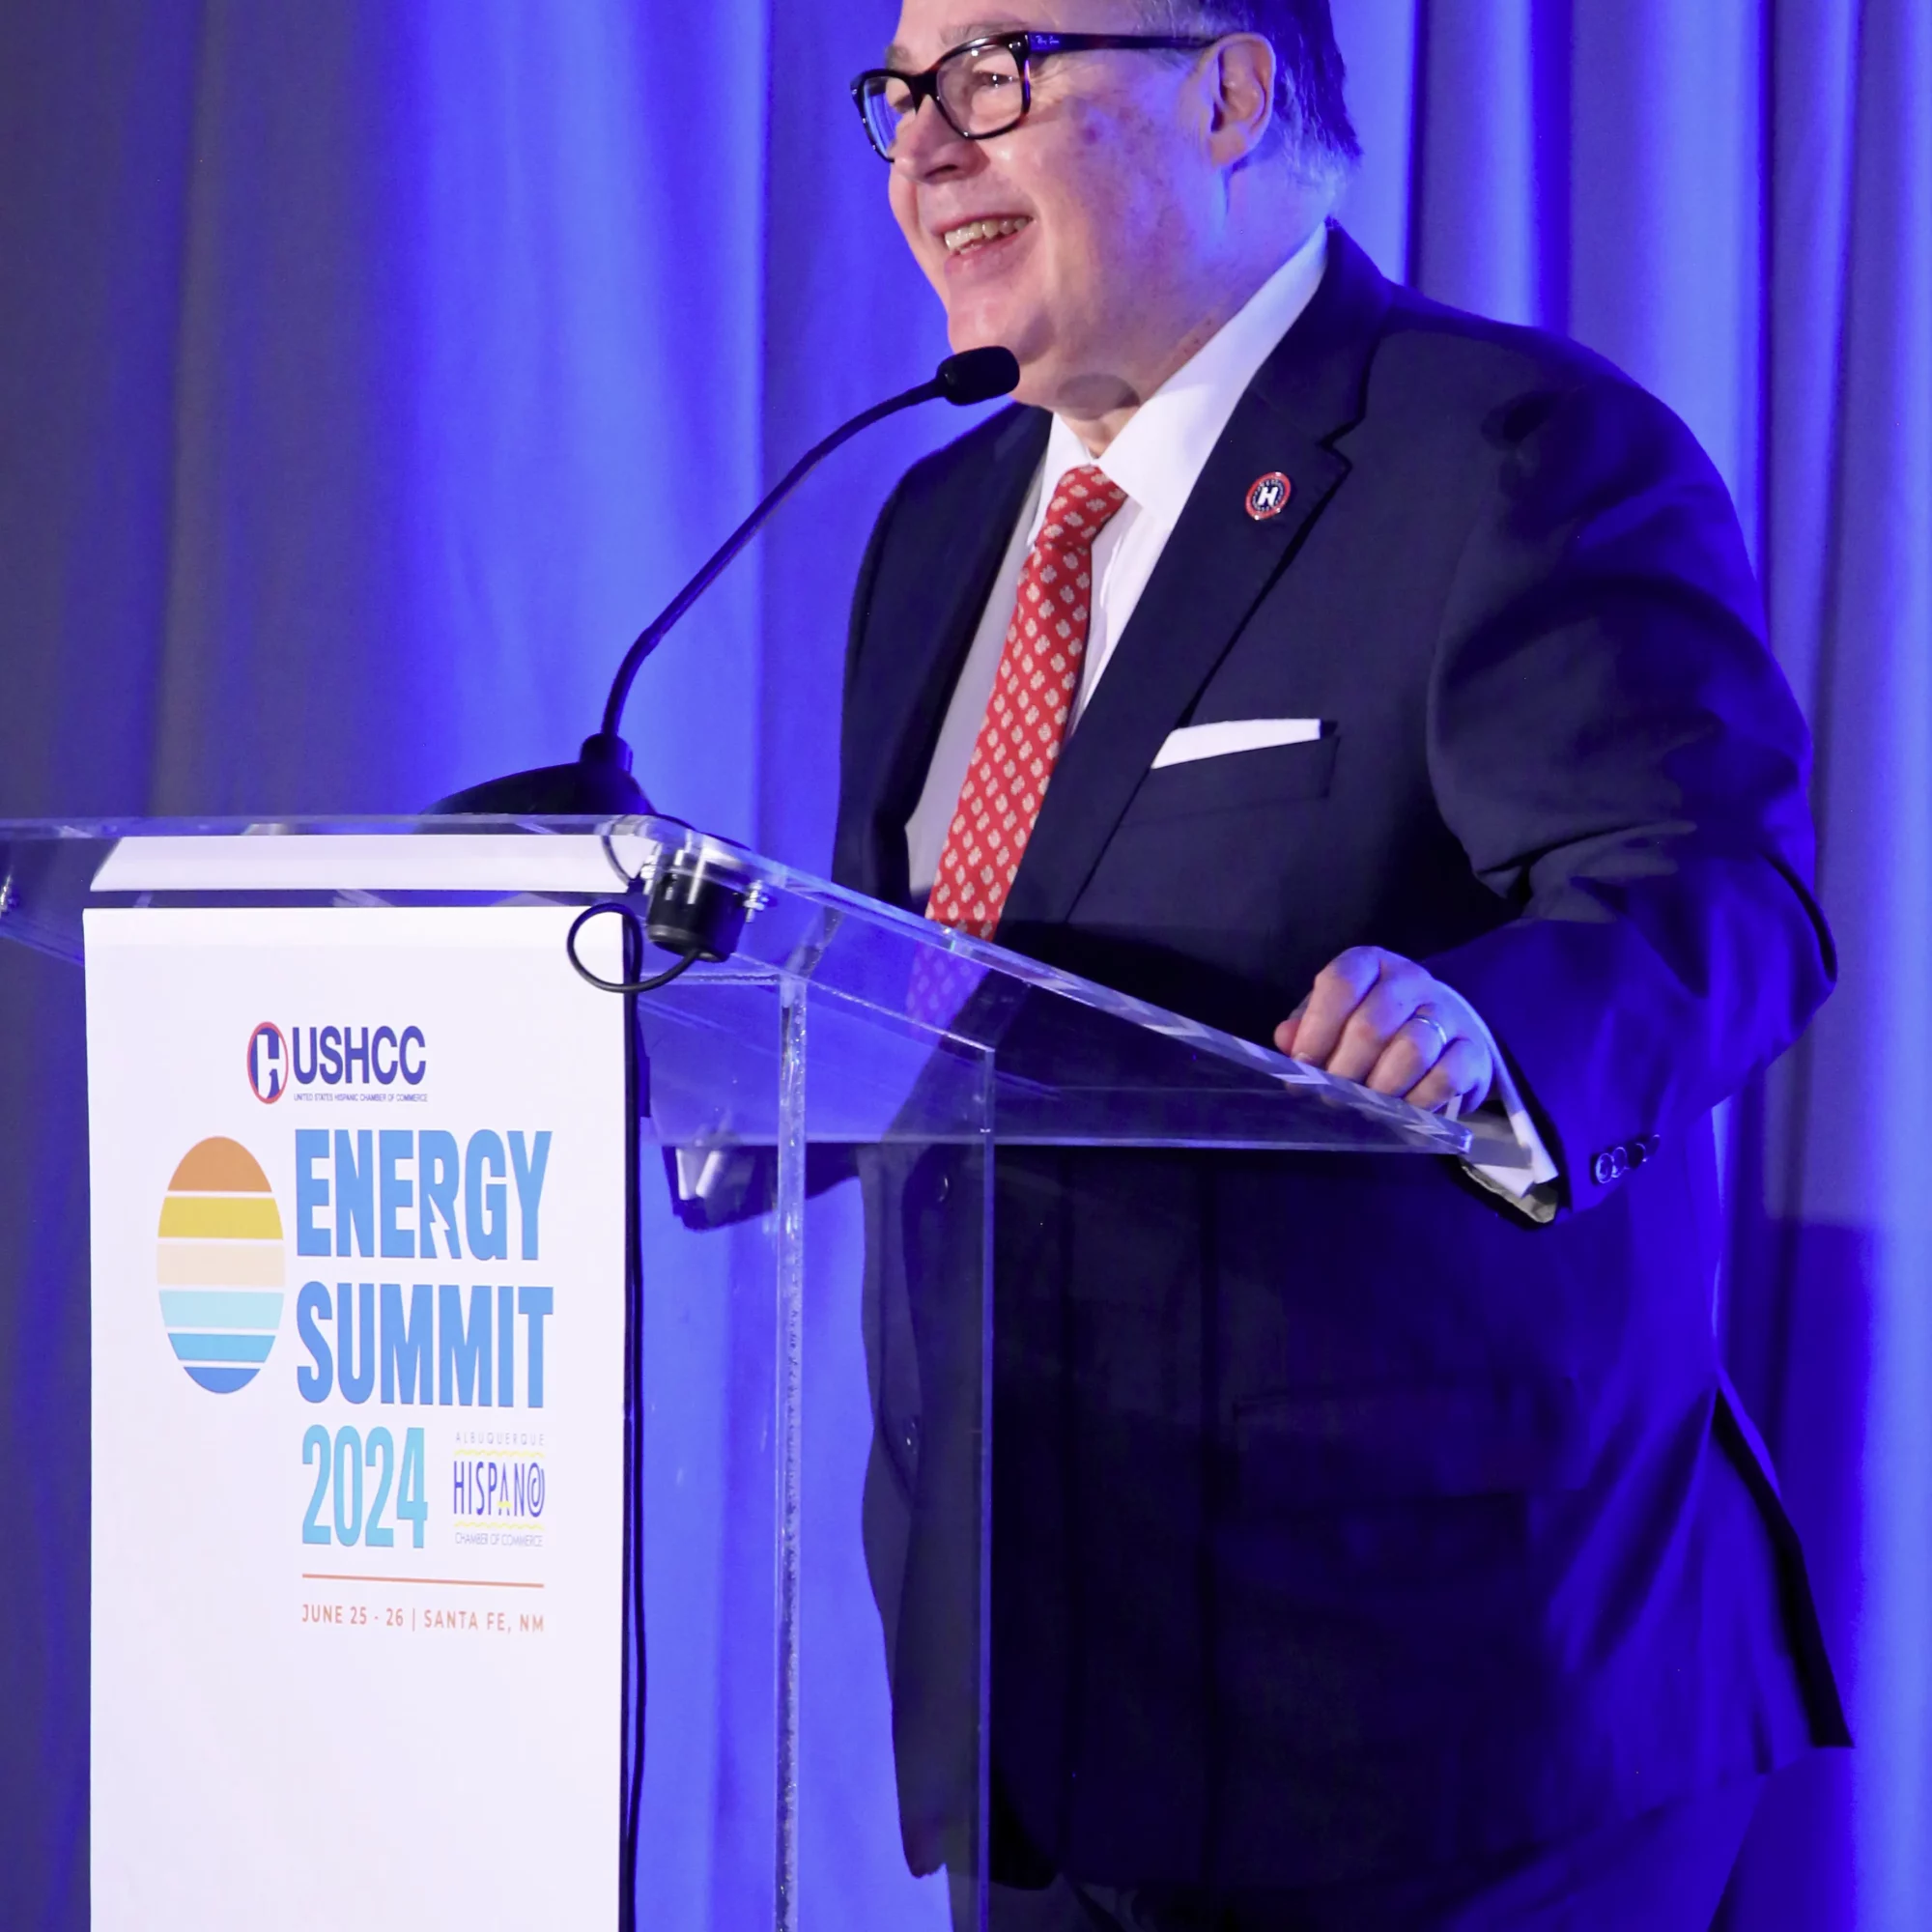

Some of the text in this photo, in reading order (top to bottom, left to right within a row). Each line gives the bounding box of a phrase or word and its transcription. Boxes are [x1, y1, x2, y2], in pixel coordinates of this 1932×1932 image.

[293, 1026, 426, 1085] USHCC
[294, 1093, 428, 1102] UNITED STATES HISPANIC CHAMBER OF COMMERCE
[295, 1128, 554, 1261] ENERGY
[297, 1281, 554, 1408] SUMMIT
[455, 1432, 545, 1446] ALBUQUERQUE
[302, 1425, 428, 1548] 2024
[455, 1532, 544, 1547] CHAMBER OF COMMERCE
[301, 1604, 343, 1624] JUNE
[350, 1605, 367, 1625] 25
[385, 1607, 404, 1627] 26
[424, 1609, 479, 1631] SANTA
[487, 1612, 511, 1634] FE,
[520, 1614, 544, 1633] NM
